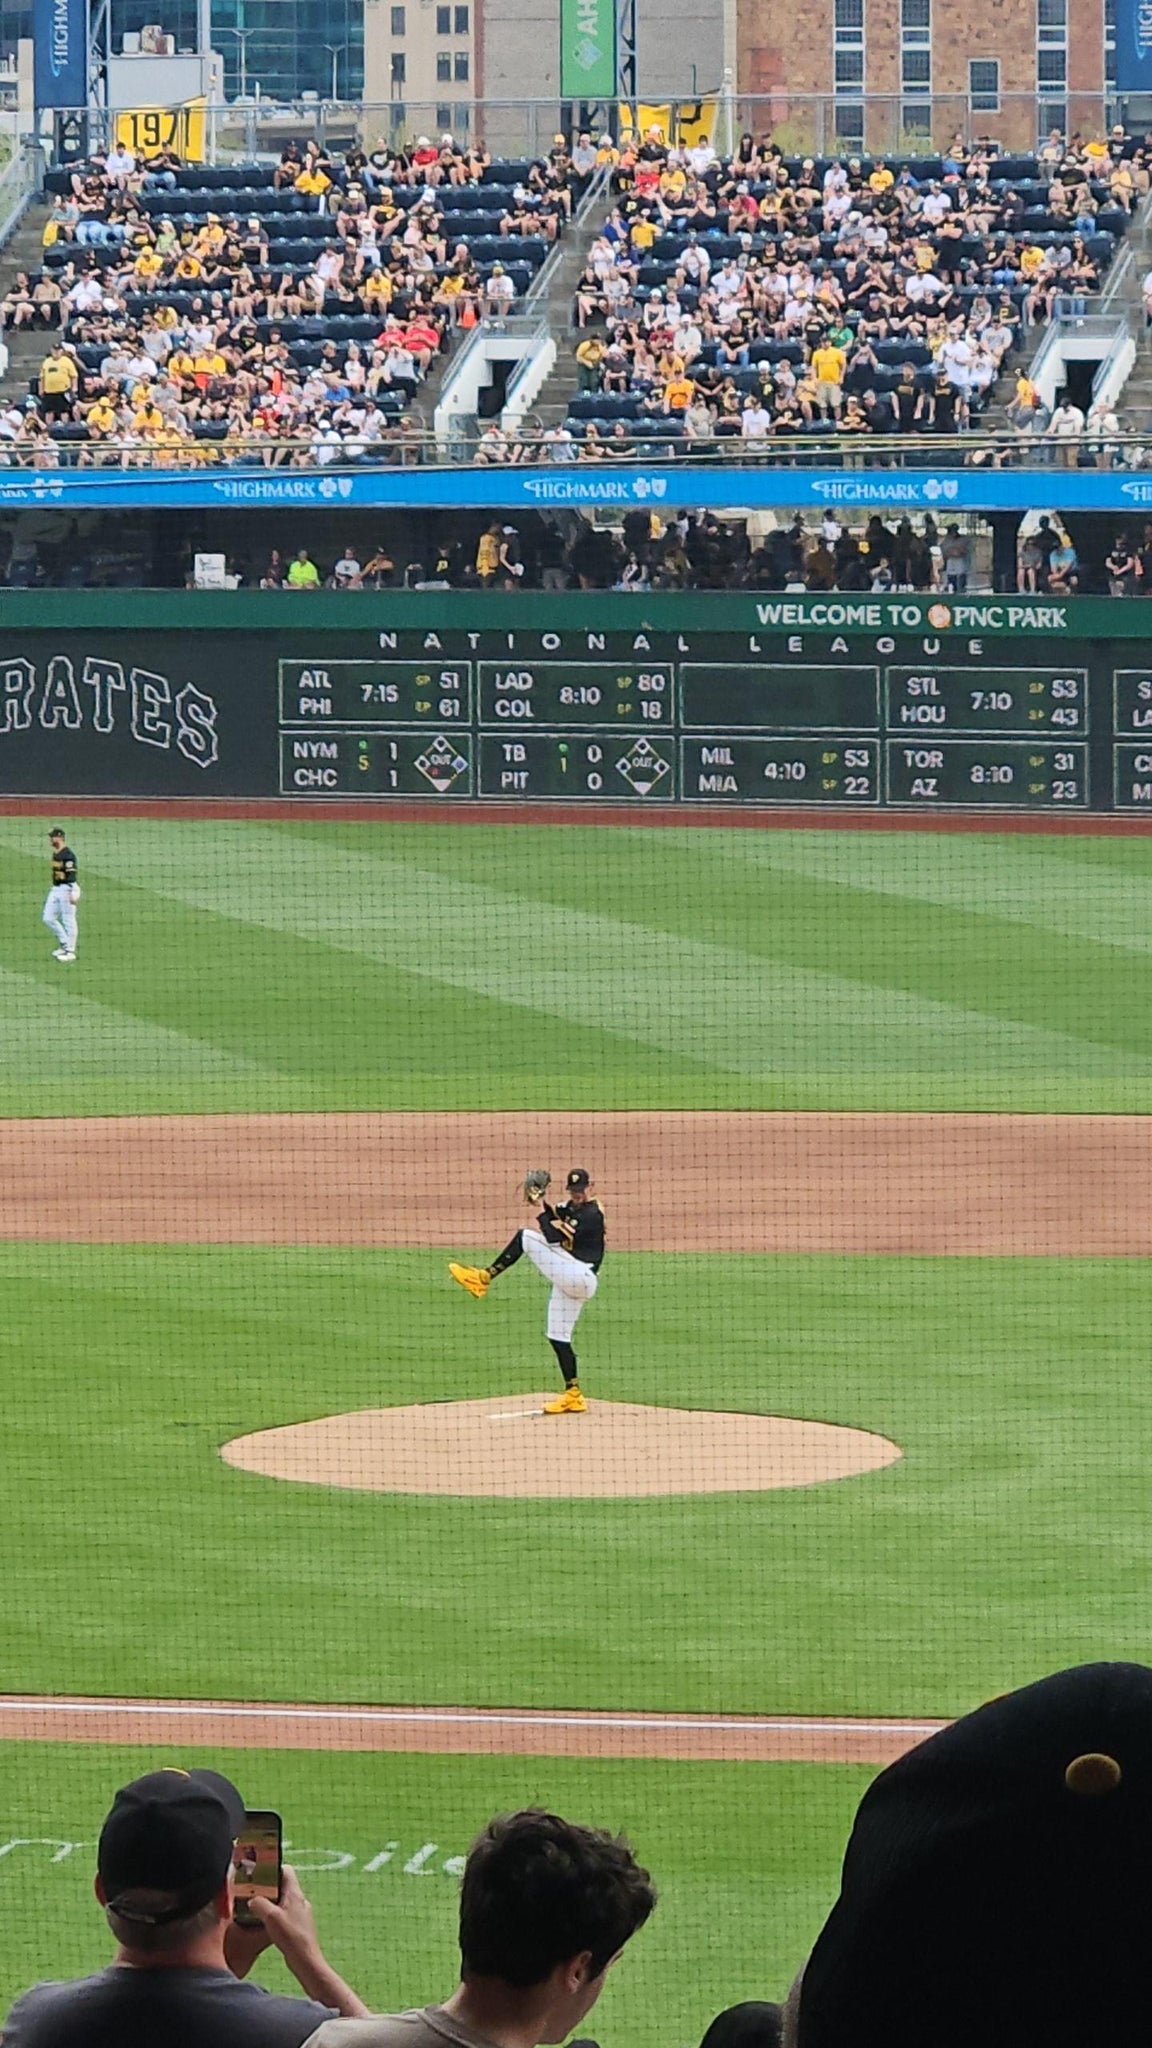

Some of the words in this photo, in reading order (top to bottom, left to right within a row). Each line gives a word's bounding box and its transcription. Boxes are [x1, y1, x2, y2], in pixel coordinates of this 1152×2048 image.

[130, 108, 191, 148] 1971
[223, 481, 316, 498] HIGHMARK
[535, 481, 630, 499] HIGHMARK
[824, 483, 920, 500] HIGHMARK
[757, 604, 882, 626] WELCOME
[887, 605, 922, 626] TO
[953, 606, 1004, 628] PNC
[1007, 607, 1068, 629] PARK
[379, 632, 690, 652] NATIONAL
[750, 635, 984, 656] LEAGUE
[299, 670, 332, 689] ATL
[440, 672, 460, 689] 51
[495, 672, 534, 691] LAD
[637, 674, 666, 692] 80
[907, 677, 941, 696] STL
[1051, 679, 1078, 699] 53
[360, 684, 400, 703] 7:15
[560, 686, 601, 705] 8:10
[970, 691, 1013, 711] 7:10
[300, 697, 332, 715] PHI
[439, 698, 460, 717] 61
[495, 699, 534, 718] COL
[640, 701, 662, 720] 18
[901, 705, 946, 724] HOU
[1051, 707, 1079, 726] 43
[293, 741, 338, 759] NYM
[390, 742, 398, 761] 1
[502, 743, 527, 762] TB
[587, 744, 603, 764] 0
[701, 747, 735, 766] MIL
[844, 749, 871, 768] 53
[903, 749, 944, 768] TOR
[430, 754, 452, 766] OUT
[632, 757, 653, 768] OUT
[1053, 752, 1075, 771] 31
[293, 768, 338, 787] CHC
[389, 769, 398, 787] 1
[501, 771, 529, 790] PIT
[764, 761, 806, 781] 4:10
[970, 765, 1013, 784] 8:10
[587, 772, 602, 790] 0
[698, 774, 738, 793] MIA
[844, 776, 870, 795] 22
[910, 778, 939, 797] AZ
[1052, 780, 1078, 799] 23
